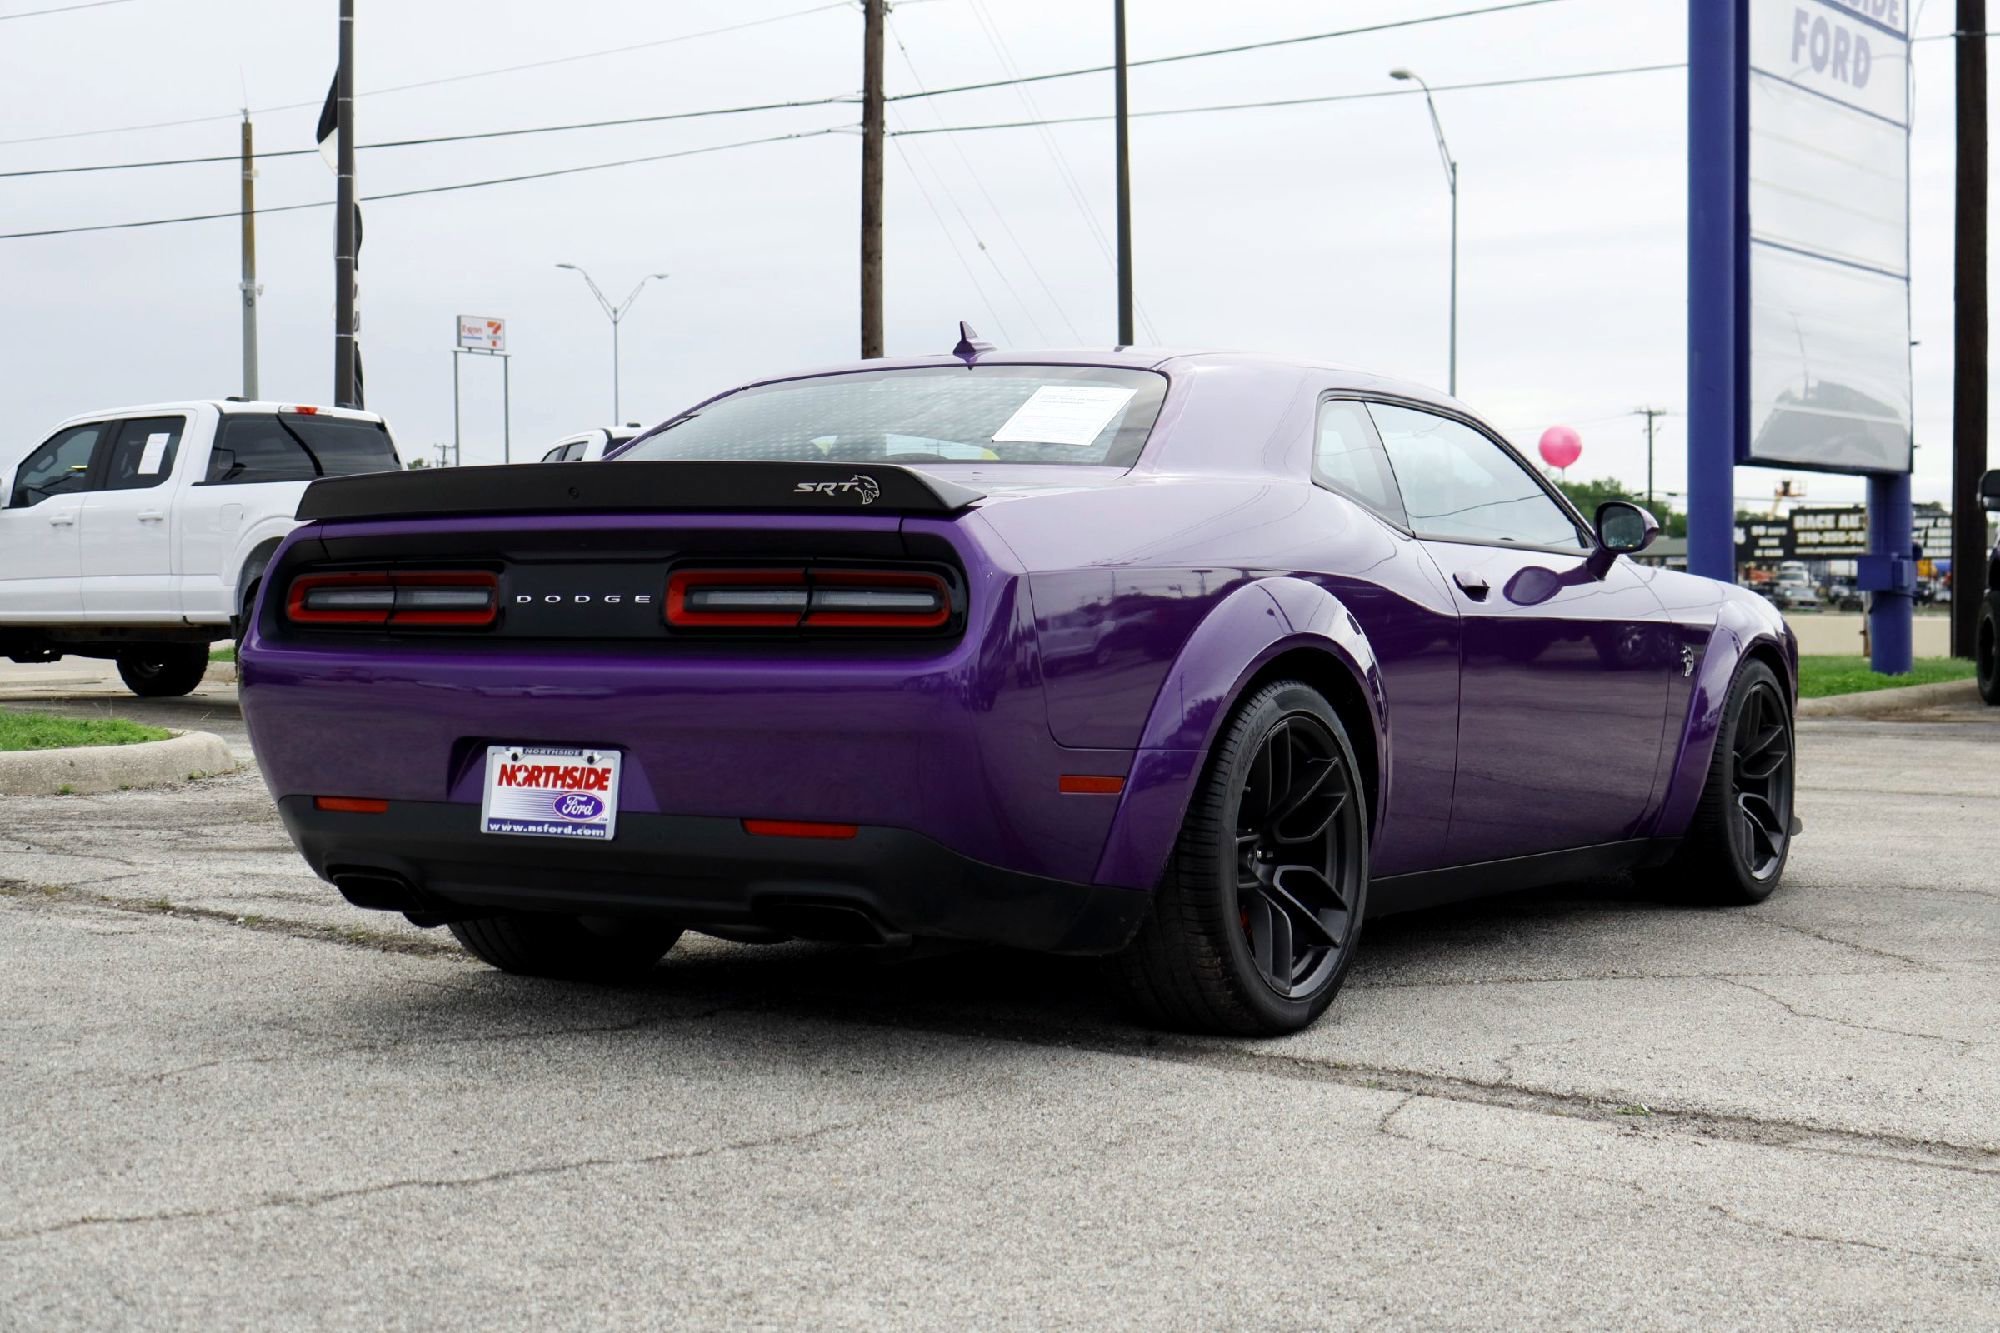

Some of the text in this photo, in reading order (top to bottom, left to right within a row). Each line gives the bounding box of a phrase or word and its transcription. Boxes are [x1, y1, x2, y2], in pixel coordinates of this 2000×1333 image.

[1791, 7, 1871, 89] FORD
[793, 482, 859, 496] SRT
[516, 595, 651, 603] DODGE
[525, 747, 580, 756] NORTHSIDE
[497, 763, 612, 791] NORTHSIDE
[562, 795, 595, 816] Ford
[489, 822, 605, 837] www.nsford.com
